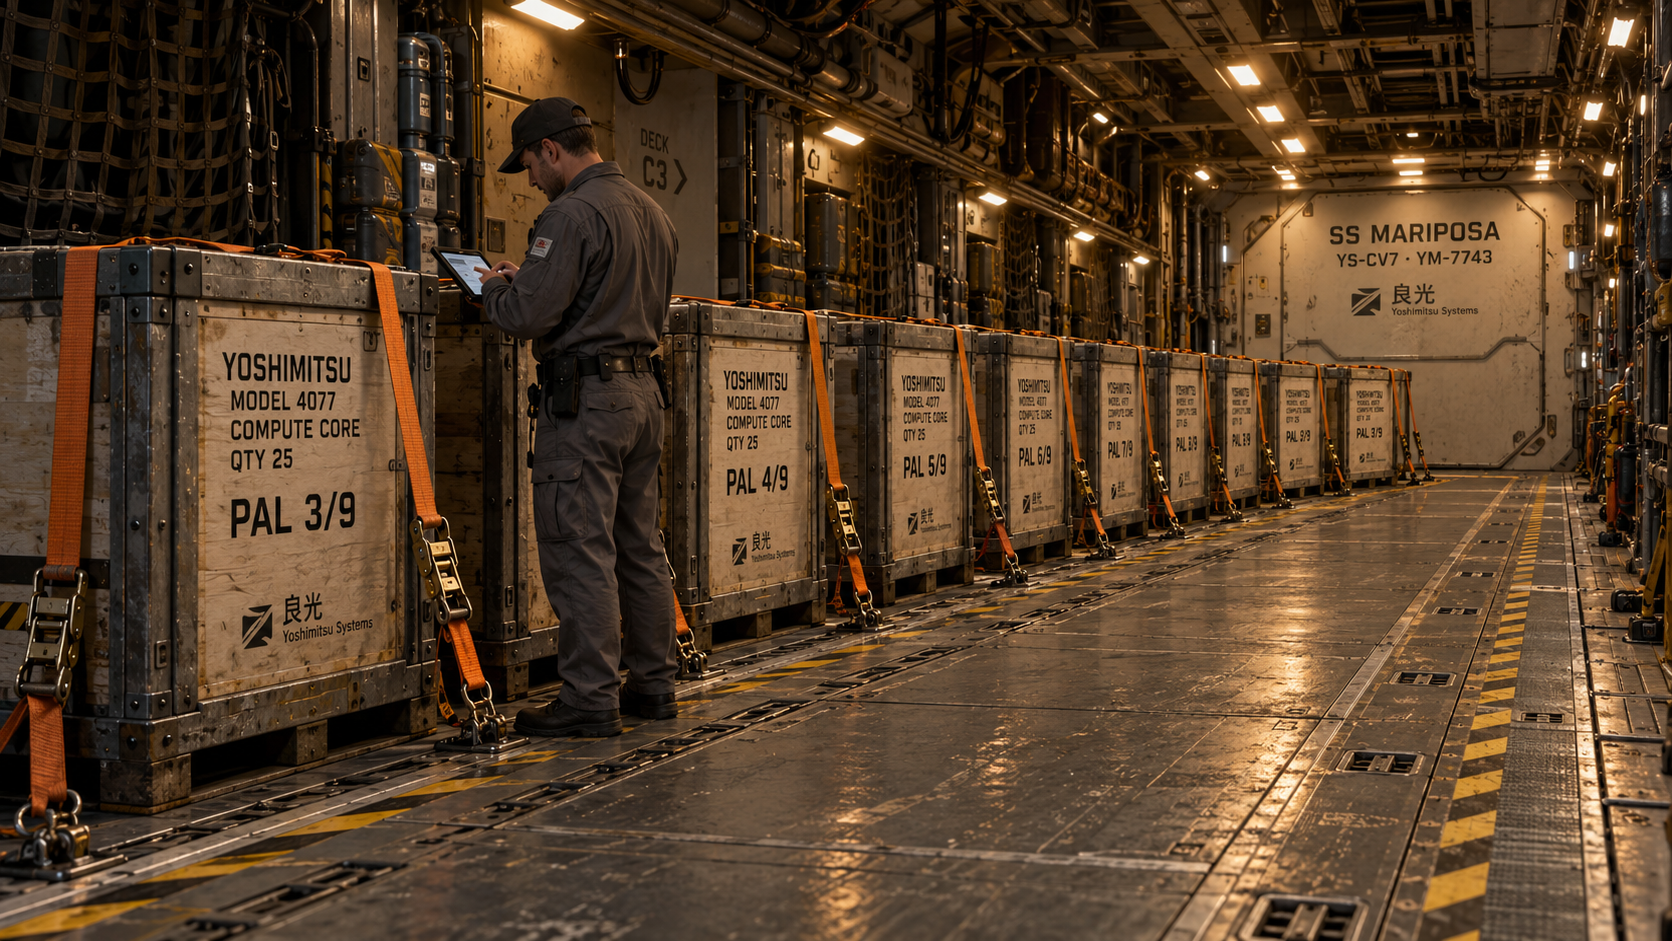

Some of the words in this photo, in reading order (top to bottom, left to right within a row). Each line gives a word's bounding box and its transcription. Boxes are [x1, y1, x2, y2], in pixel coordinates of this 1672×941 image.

[641, 128, 669, 154] DECK
[643, 155, 667, 190] C3
[1329, 225, 1360, 245] SS
[1371, 221, 1501, 244] MARIPOSA
[1336, 252, 1399, 267] YS-CV7
[1416, 249, 1493, 265] YM-7743
[1391, 283, 1436, 305] 良光
[1391, 306, 1438, 316] Yoshimitsu
[1441, 306, 1479, 317] Systems
[222, 352, 351, 383] YOSHIMITSU
[723, 370, 788, 391] YOSHIMITSU
[901, 375, 945, 392] YOSHIMITSU
[231, 390, 291, 411] MODEL
[296, 391, 336, 411] 4077
[727, 396, 757, 410] MODEL
[759, 396, 779, 410] 4077
[231, 419, 313, 440] COMPUTE
[320, 418, 360, 438] CORE
[727, 415, 768, 430] COMPUTE
[770, 415, 791, 428] CORE
[1356, 427, 1369, 439] PAL
[727, 436, 744, 452] QTY
[747, 435, 758, 450] 25
[903, 428, 916, 442] QTY
[1286, 430, 1298, 443] PAL
[231, 449, 266, 473] QTY
[272, 448, 293, 469] 25
[1019, 447, 1035, 467] PAL
[1037, 445, 1052, 466] 6/9
[1108, 441, 1120, 459] PAL
[1121, 440, 1133, 458] 7/9
[903, 455, 924, 479] PAL
[928, 453, 947, 477] 5/9
[727, 467, 757, 496] PAL
[762, 464, 788, 493] 4/9
[231, 496, 292, 539] PAL
[305, 491, 356, 531] 3/9
[751, 530, 771, 552] 良光
[283, 592, 323, 626] 良光
[282, 625, 334, 643] Yoshimitsu
[336, 619, 373, 635] Systems
